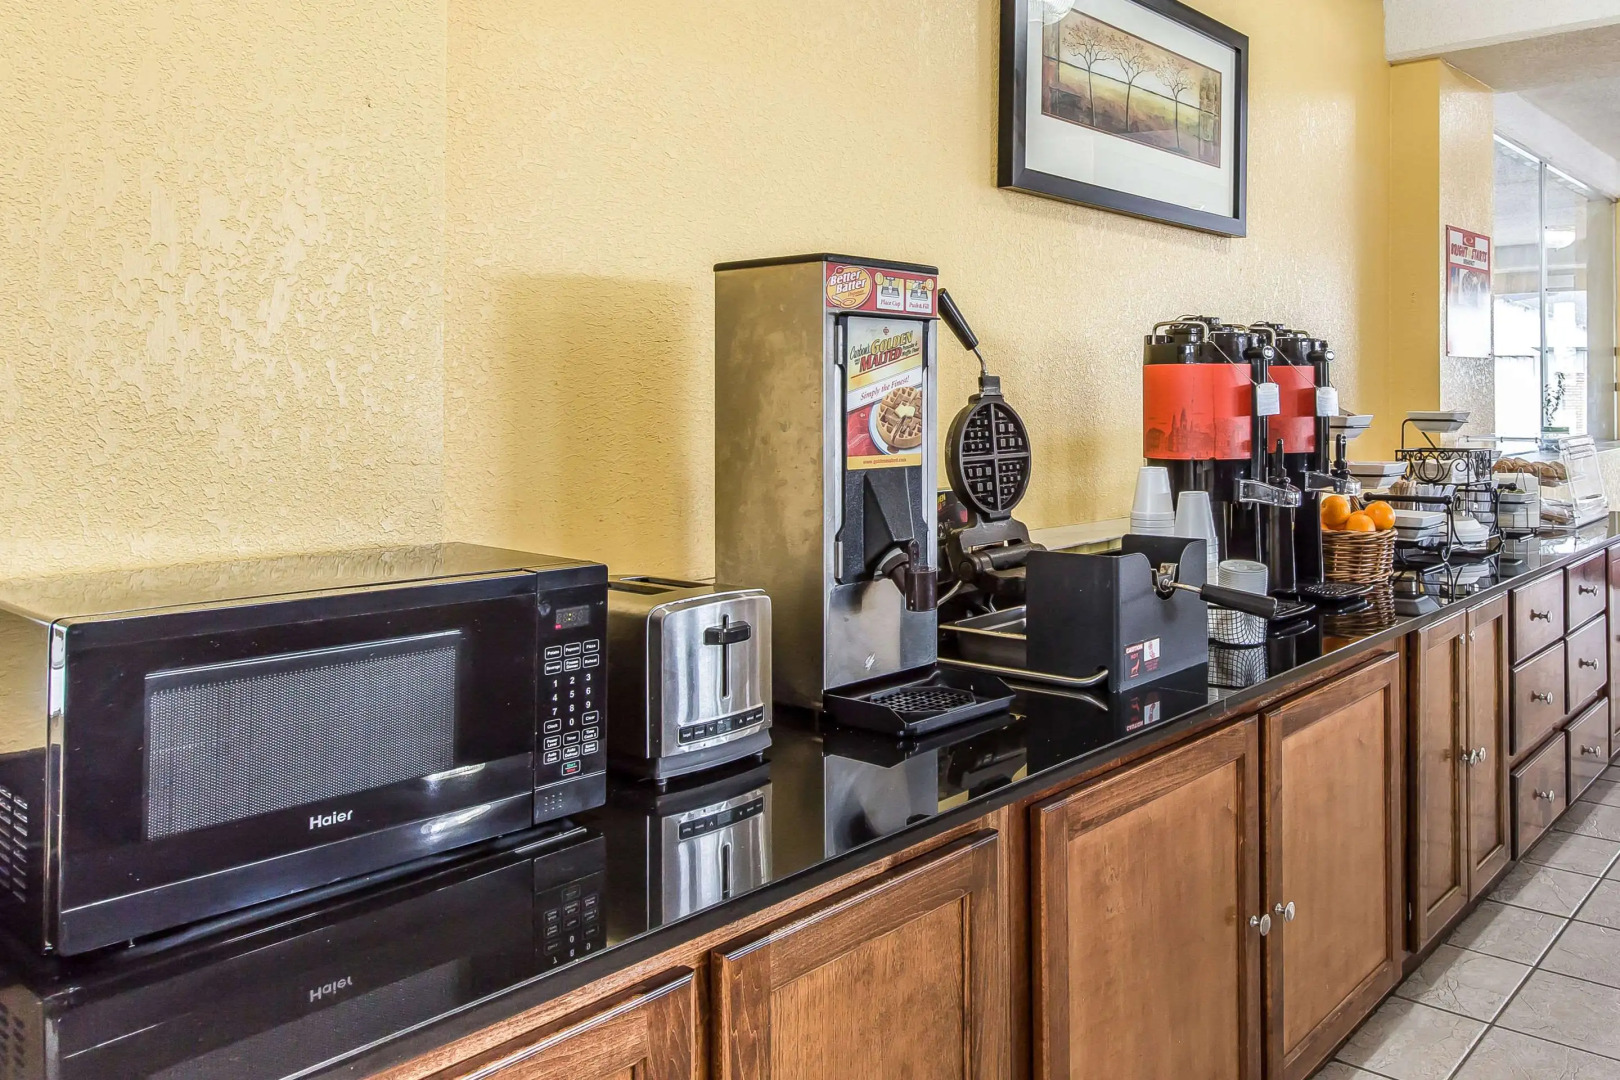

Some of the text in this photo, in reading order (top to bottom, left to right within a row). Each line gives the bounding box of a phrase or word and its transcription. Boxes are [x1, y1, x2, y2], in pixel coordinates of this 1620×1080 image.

[1451, 243, 1487, 262] BRIGHT STARTS
[830, 271, 861, 286] Better
[836, 279, 866, 293] Batter
[871, 331, 913, 355] GOLDEN
[860, 347, 903, 372] MALTED
[860, 375, 910, 401] Simply the Finest!
[553, 680, 558, 688] 1
[569, 677, 575, 685] 2
[569, 690, 575, 698] 5
[586, 687, 591, 695] 6
[552, 694, 558, 702] 4
[569, 704, 575, 712] 8
[586, 701, 591, 709] 9
[552, 708, 558, 716] 7
[569, 718, 575, 726] 0
[309, 810, 353, 830] Haier
